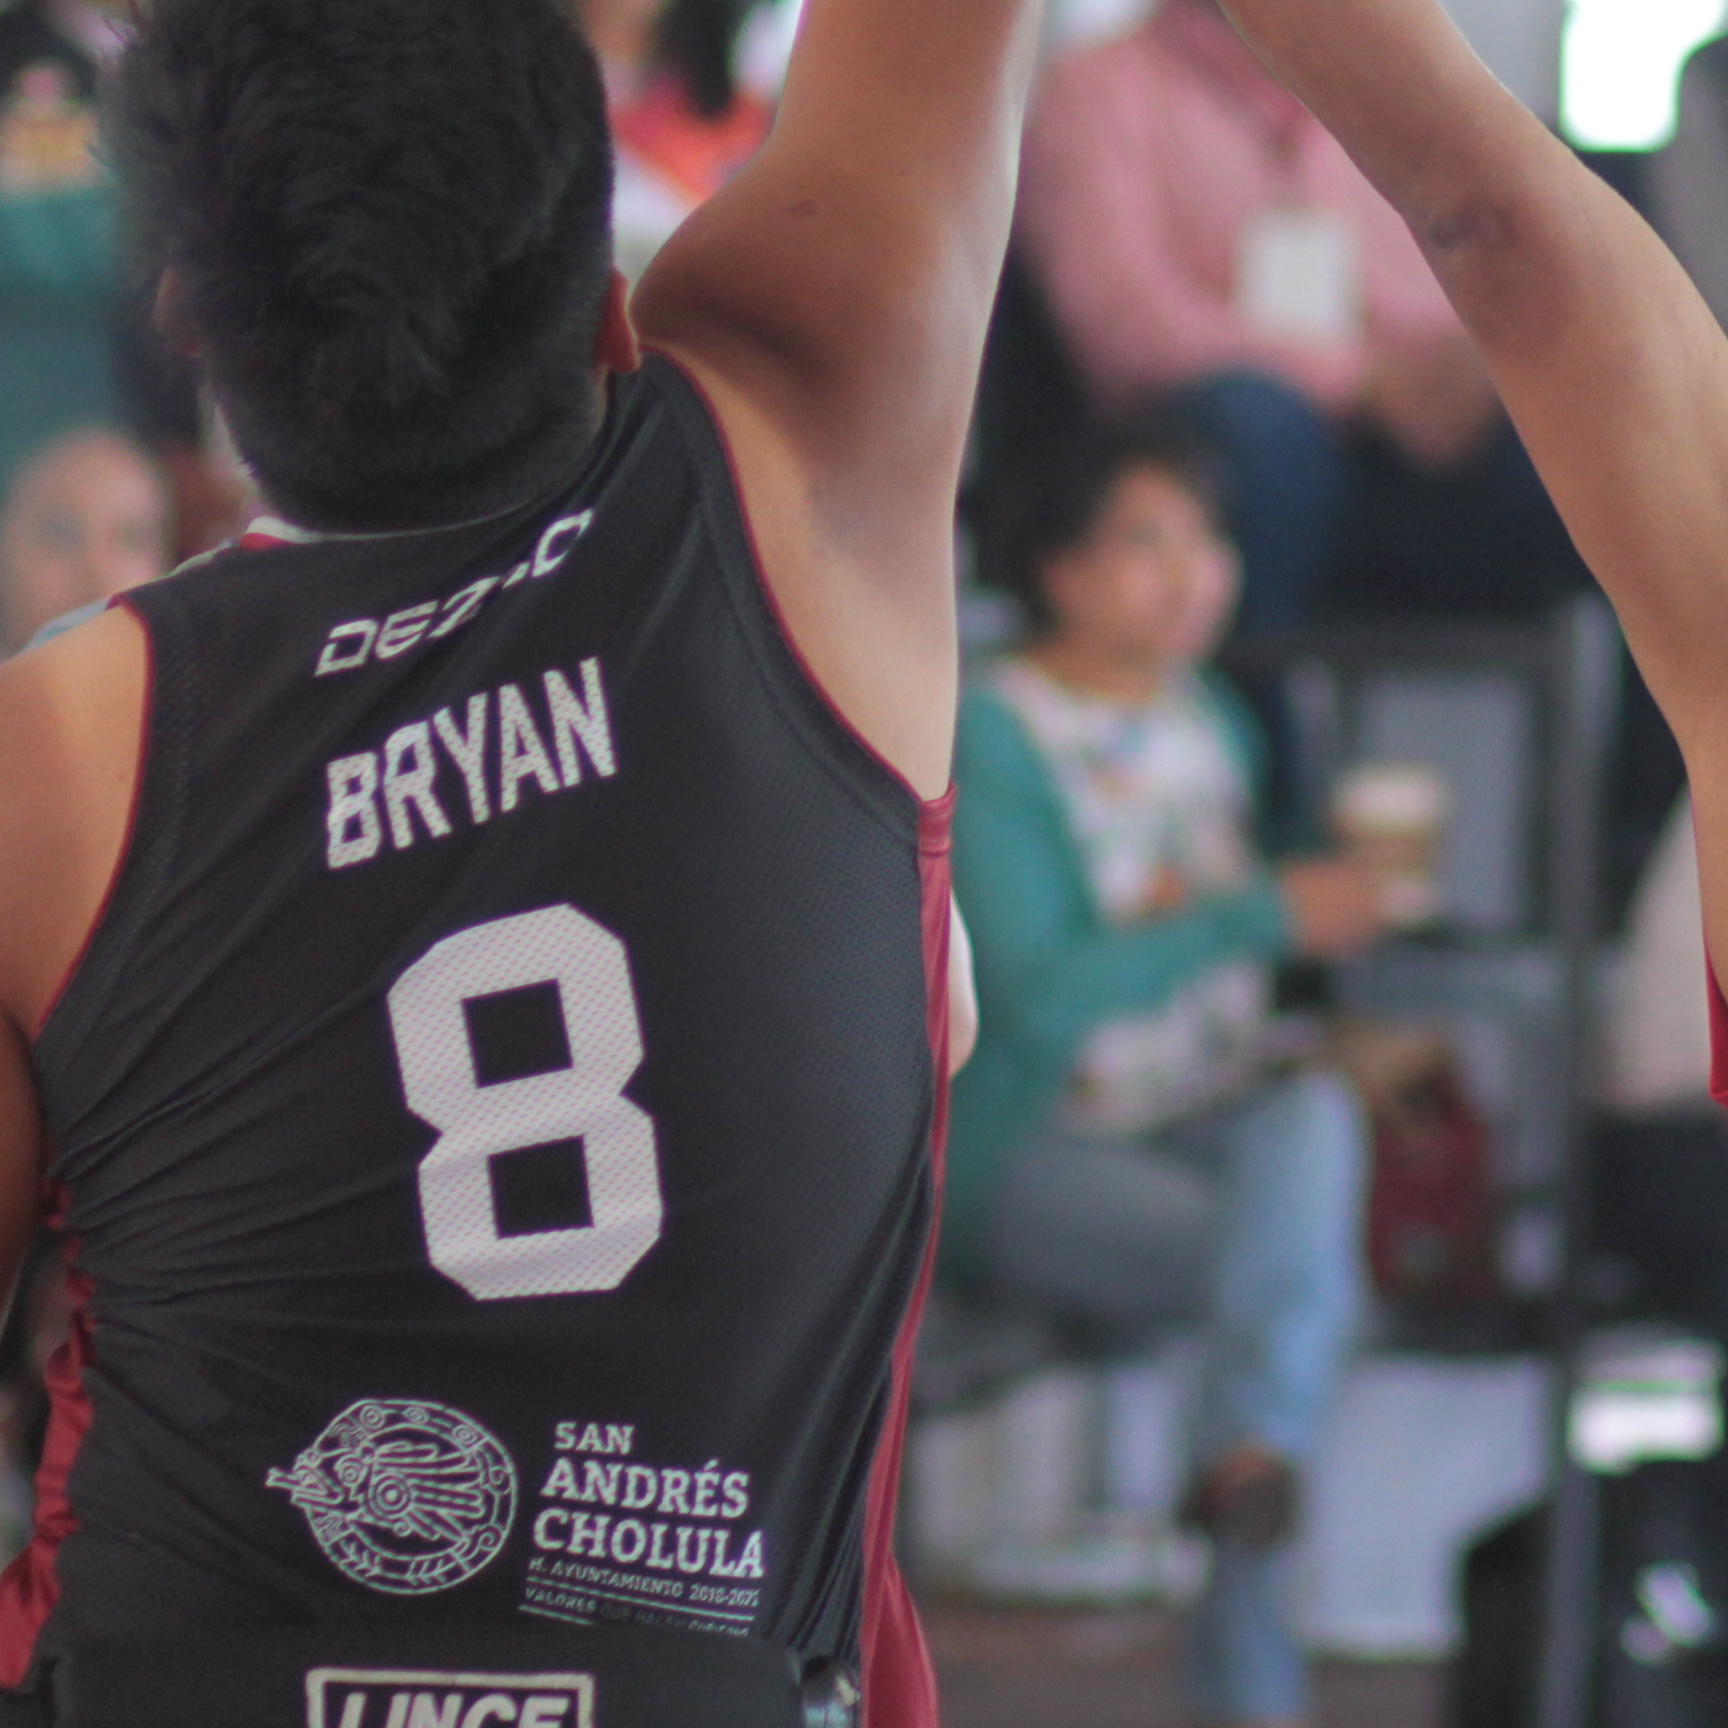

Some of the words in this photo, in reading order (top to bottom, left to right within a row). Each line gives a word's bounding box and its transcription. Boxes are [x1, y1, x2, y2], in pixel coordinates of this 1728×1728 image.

[327, 656, 616, 870] BRYAN
[387, 903, 663, 1301] 8
[554, 1421, 635, 1455] SAN
[539, 1457, 750, 1519] ANDRÉS
[533, 1507, 764, 1578] CHOLULA
[525, 1586, 597, 1614] VALORES
[550, 1559, 684, 1598] AYUNTAMIENTO
